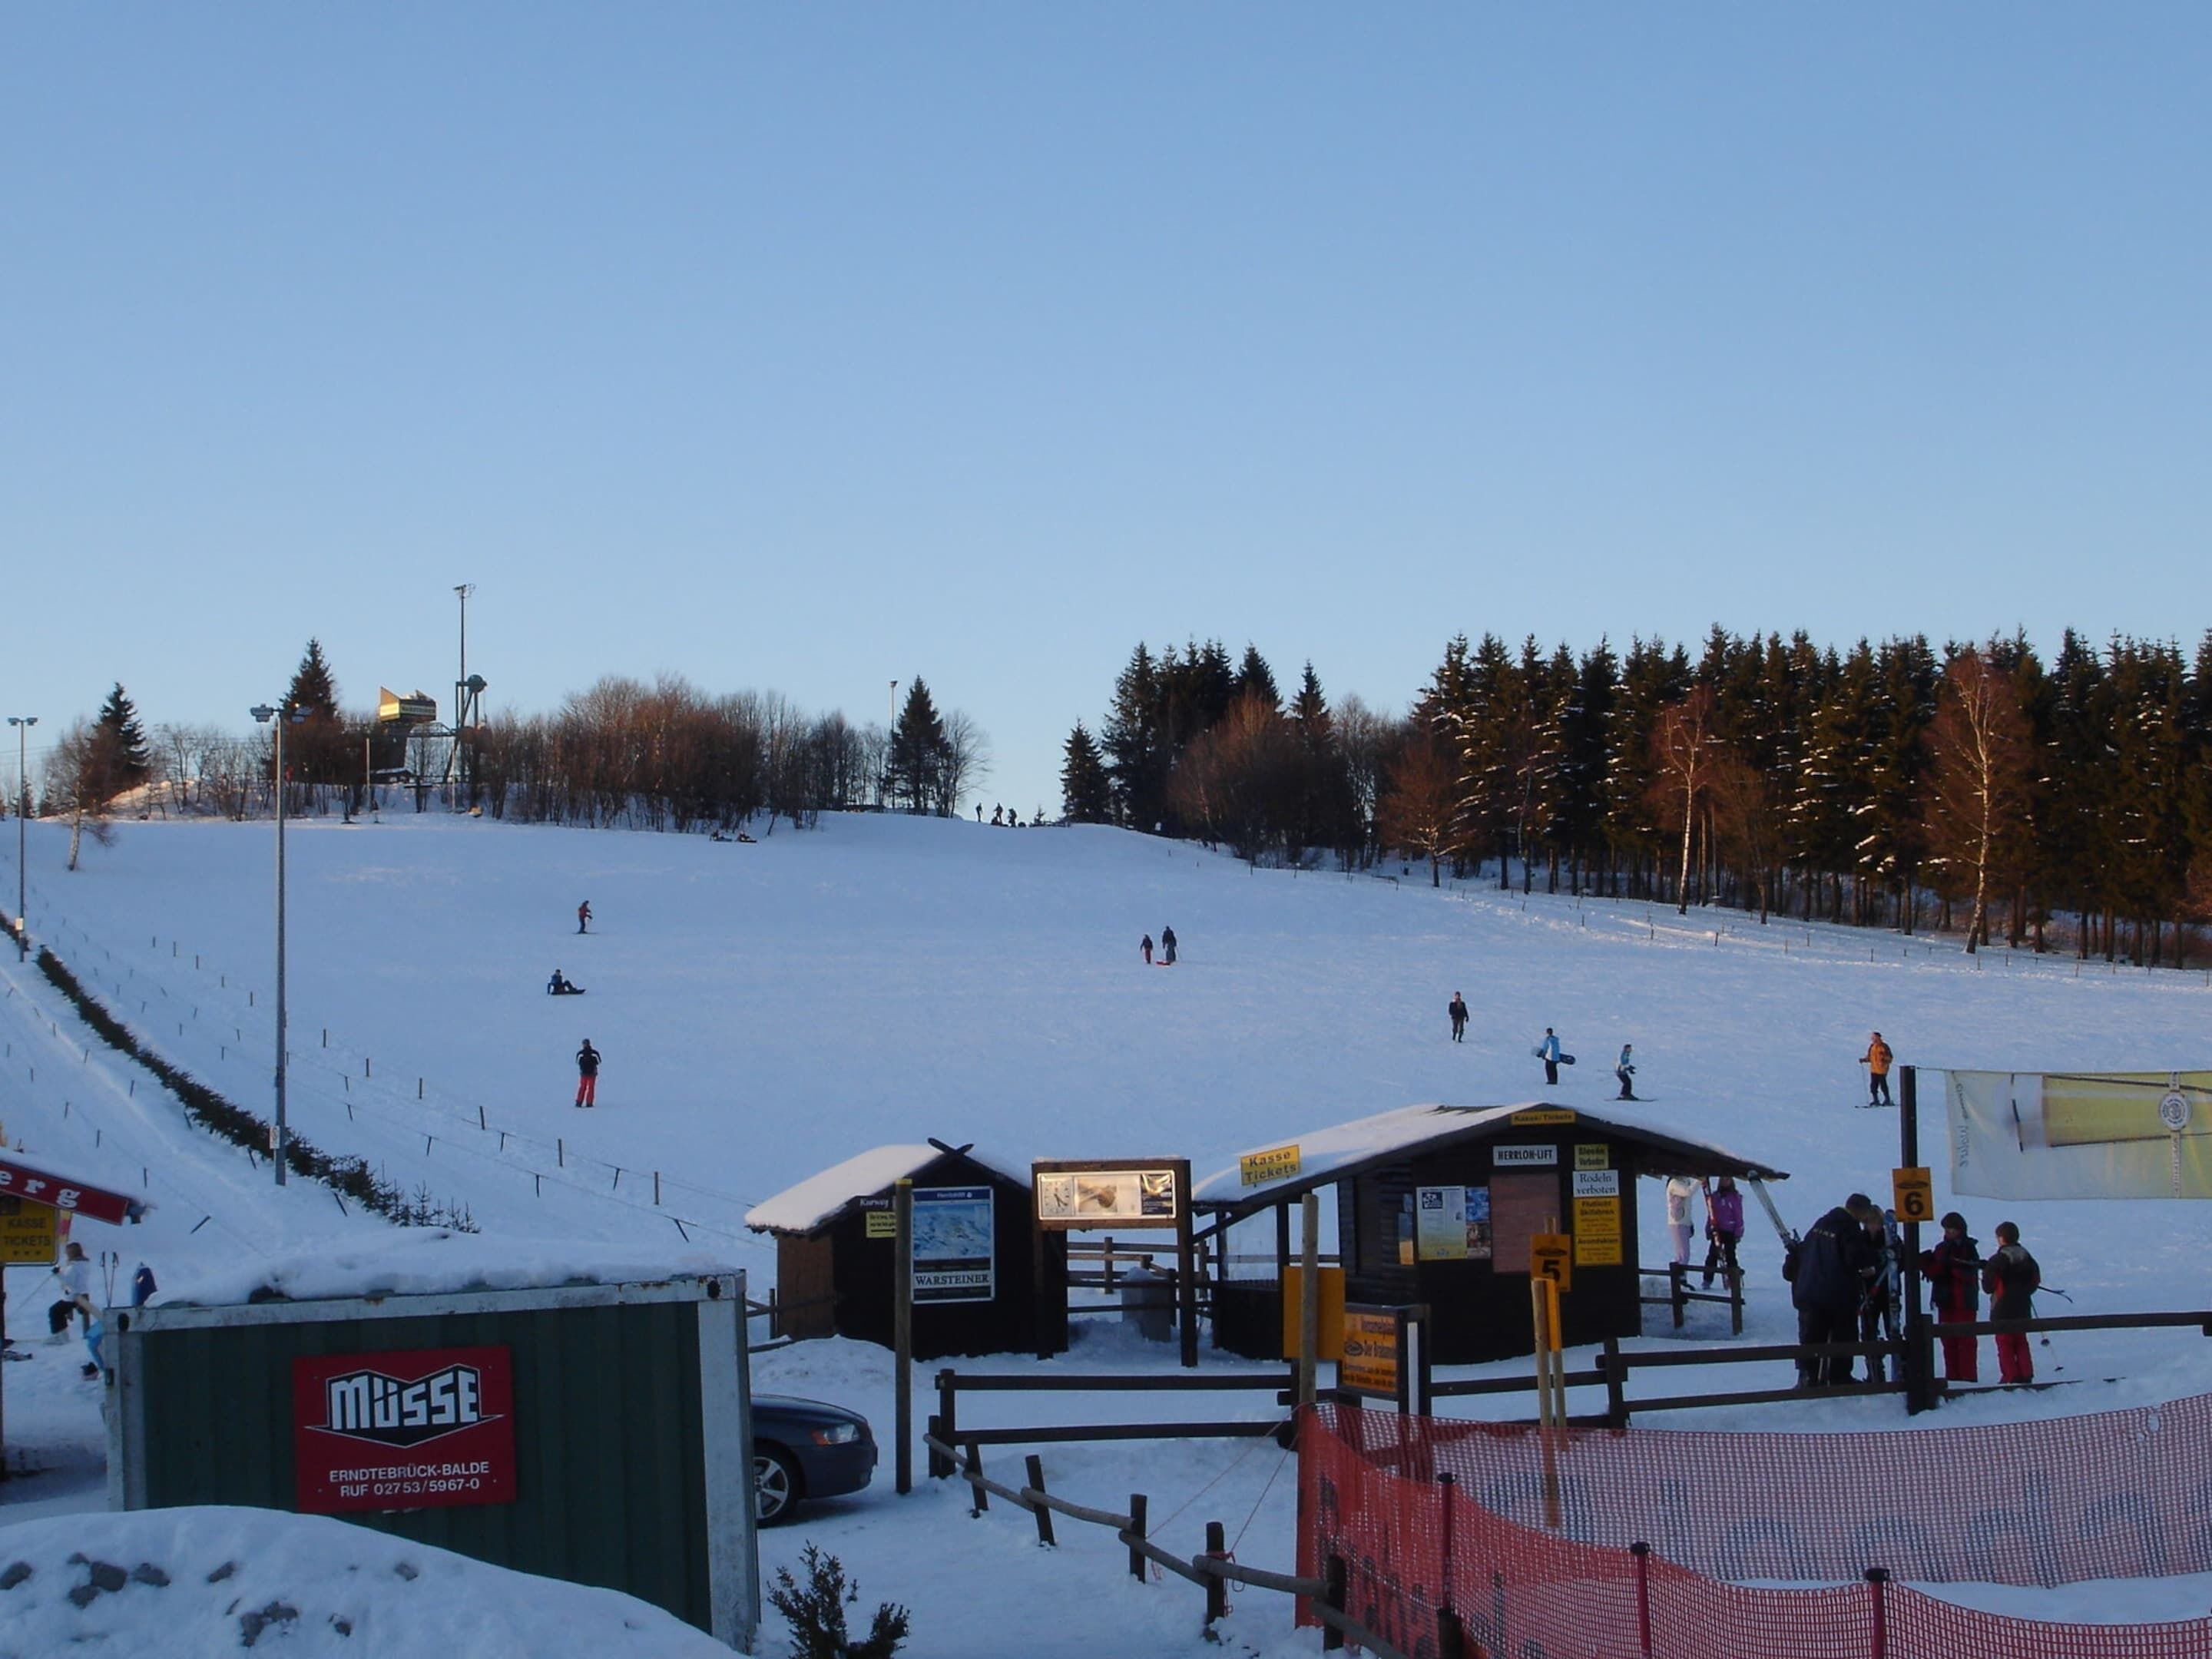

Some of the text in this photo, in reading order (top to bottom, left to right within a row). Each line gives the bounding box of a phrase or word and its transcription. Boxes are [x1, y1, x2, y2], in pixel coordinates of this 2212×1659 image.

[1249, 1151, 1291, 1167] Kasse
[1498, 1149, 1553, 1161] HERRLOH-LIFT
[1245, 1164, 1297, 1182] Tickets
[1579, 1172, 1612, 1183] Rodeln
[1576, 1184, 1616, 1194] verboten
[1905, 1191, 1924, 1217] 6
[8, 1217, 47, 1229] KASSE
[3, 1234, 51, 1247] TICKETS
[1542, 1259, 1561, 1283] 5
[915, 1273, 989, 1286] WARSTEINER
[329, 1461, 490, 1483] ERNDTEBRÜCK-BALDE
[340, 1477, 480, 1498] RUF 02753/5967-0
